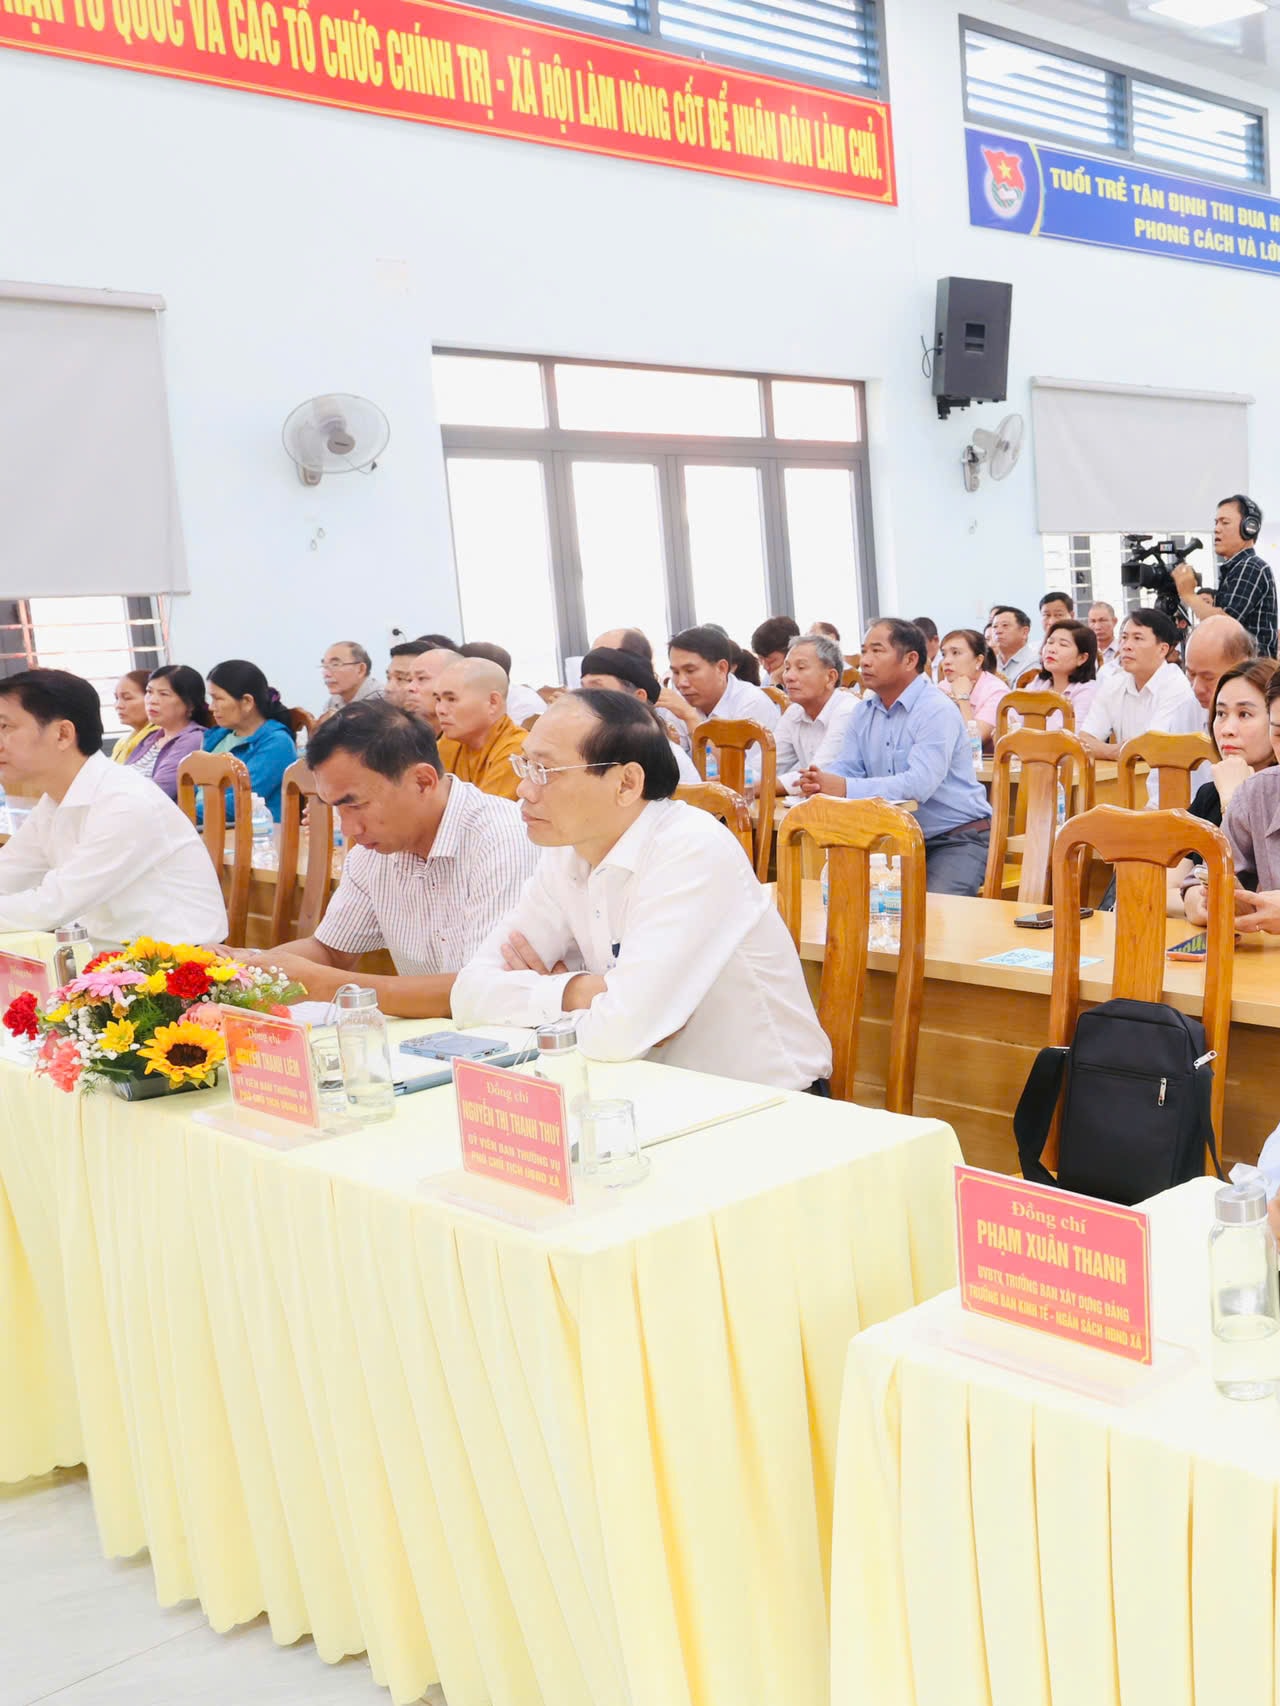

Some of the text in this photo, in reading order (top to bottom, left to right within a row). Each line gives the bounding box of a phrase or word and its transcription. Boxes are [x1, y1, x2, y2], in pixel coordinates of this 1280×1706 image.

[282, 0, 316, 73] TỔ
[320, 10, 384, 87] CHỨC
[386, 22, 456, 100] CHÍNH
[457, 43, 493, 120] TRỊ
[496, 78, 505, 92] -
[507, 48, 539, 117] XÃ
[541, 53, 574, 133] HỘI
[577, 60, 618, 131] LÀM
[620, 68, 671, 141] NÒNG
[673, 76, 705, 147] CỐT
[708, 80, 732, 152] ĐỂ
[733, 97, 779, 161] NHÂN
[779, 105, 813, 168] DÂN
[815, 111, 848, 174] LÀM
[849, 116, 883, 180] CHỦ.
[1050, 166, 1092, 195] TUỔI
[1095, 175, 1129, 202] TRẺ
[1131, 183, 1165, 209] TÂN
[1168, 191, 1207, 218] ĐỊNH
[1209, 201, 1235, 224] THI
[1238, 206, 1267, 231] ĐUA
[1134, 218, 1190, 246] PHONG
[1193, 227, 1234, 254] CÁCH
[1237, 231, 1256, 259] VÀ
[487, 1081, 529, 1104] Đồng chí
[462, 1098, 495, 1128] NGUYỄN
[495, 1108, 509, 1136] THỊ
[510, 1112, 538, 1140] THANH
[1011, 1200, 1087, 1234] Đồng chí
[977, 1219, 1126, 1285] PHẠM XUÂN THANH
[1000, 1295, 1017, 1311] BAN
[1018, 1299, 1037, 1316] KINH
[1039, 1303, 1049, 1321] TẾ
[1055, 1311, 1079, 1331] NGÂN
[1080, 1317, 1103, 1338] SÁCH
[1130, 1331, 1142, 1350] XÃ
[1005, 1272, 1038, 1295] TRƯỞNG
[1039, 1284, 1058, 1301] BAN
[1060, 1287, 1076, 1306] XÂY
[1078, 1294, 1103, 1315] DỰNG
[1104, 1300, 1129, 1323] ĐẢNG
